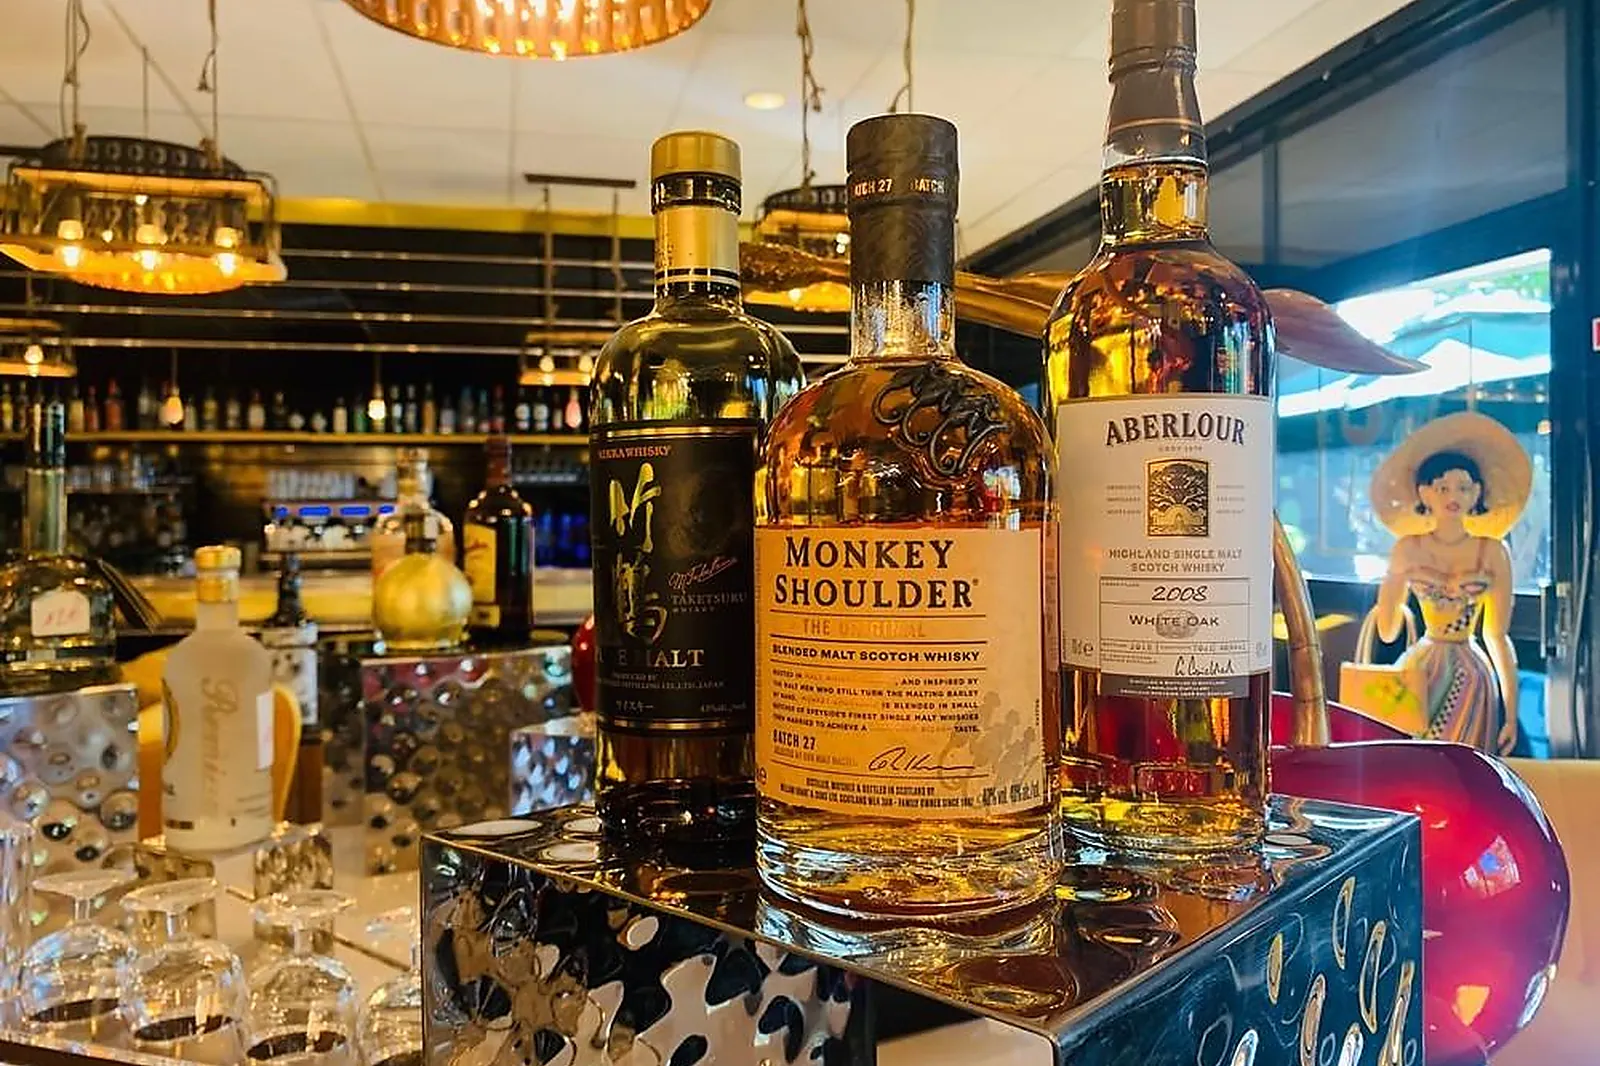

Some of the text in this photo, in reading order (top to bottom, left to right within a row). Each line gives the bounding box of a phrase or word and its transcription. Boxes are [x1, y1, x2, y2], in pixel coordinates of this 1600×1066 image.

[878, 179, 893, 193] 27
[1106, 412, 1246, 446] ABERLOUR
[785, 536, 954, 569] MONKEY
[1109, 549, 1242, 560] HIGHLAND SINGLE MALT
[1131, 562, 1225, 573] SCOTCH WHISKY
[775, 573, 973, 608] SHOULDER
[1151, 585, 1209, 602] 2008
[803, 618, 831, 636] THE
[1129, 614, 1220, 627] WHITE OAK
[772, 643, 980, 662] BLENDED MALT SCOTCH WHISKY
[901, 679, 920, 687] AND
[837, 688, 858, 696] STILL
[906, 690, 944, 698] MALTING
[914, 713, 936, 721] MALT
[773, 728, 816, 750] BATCH 27
